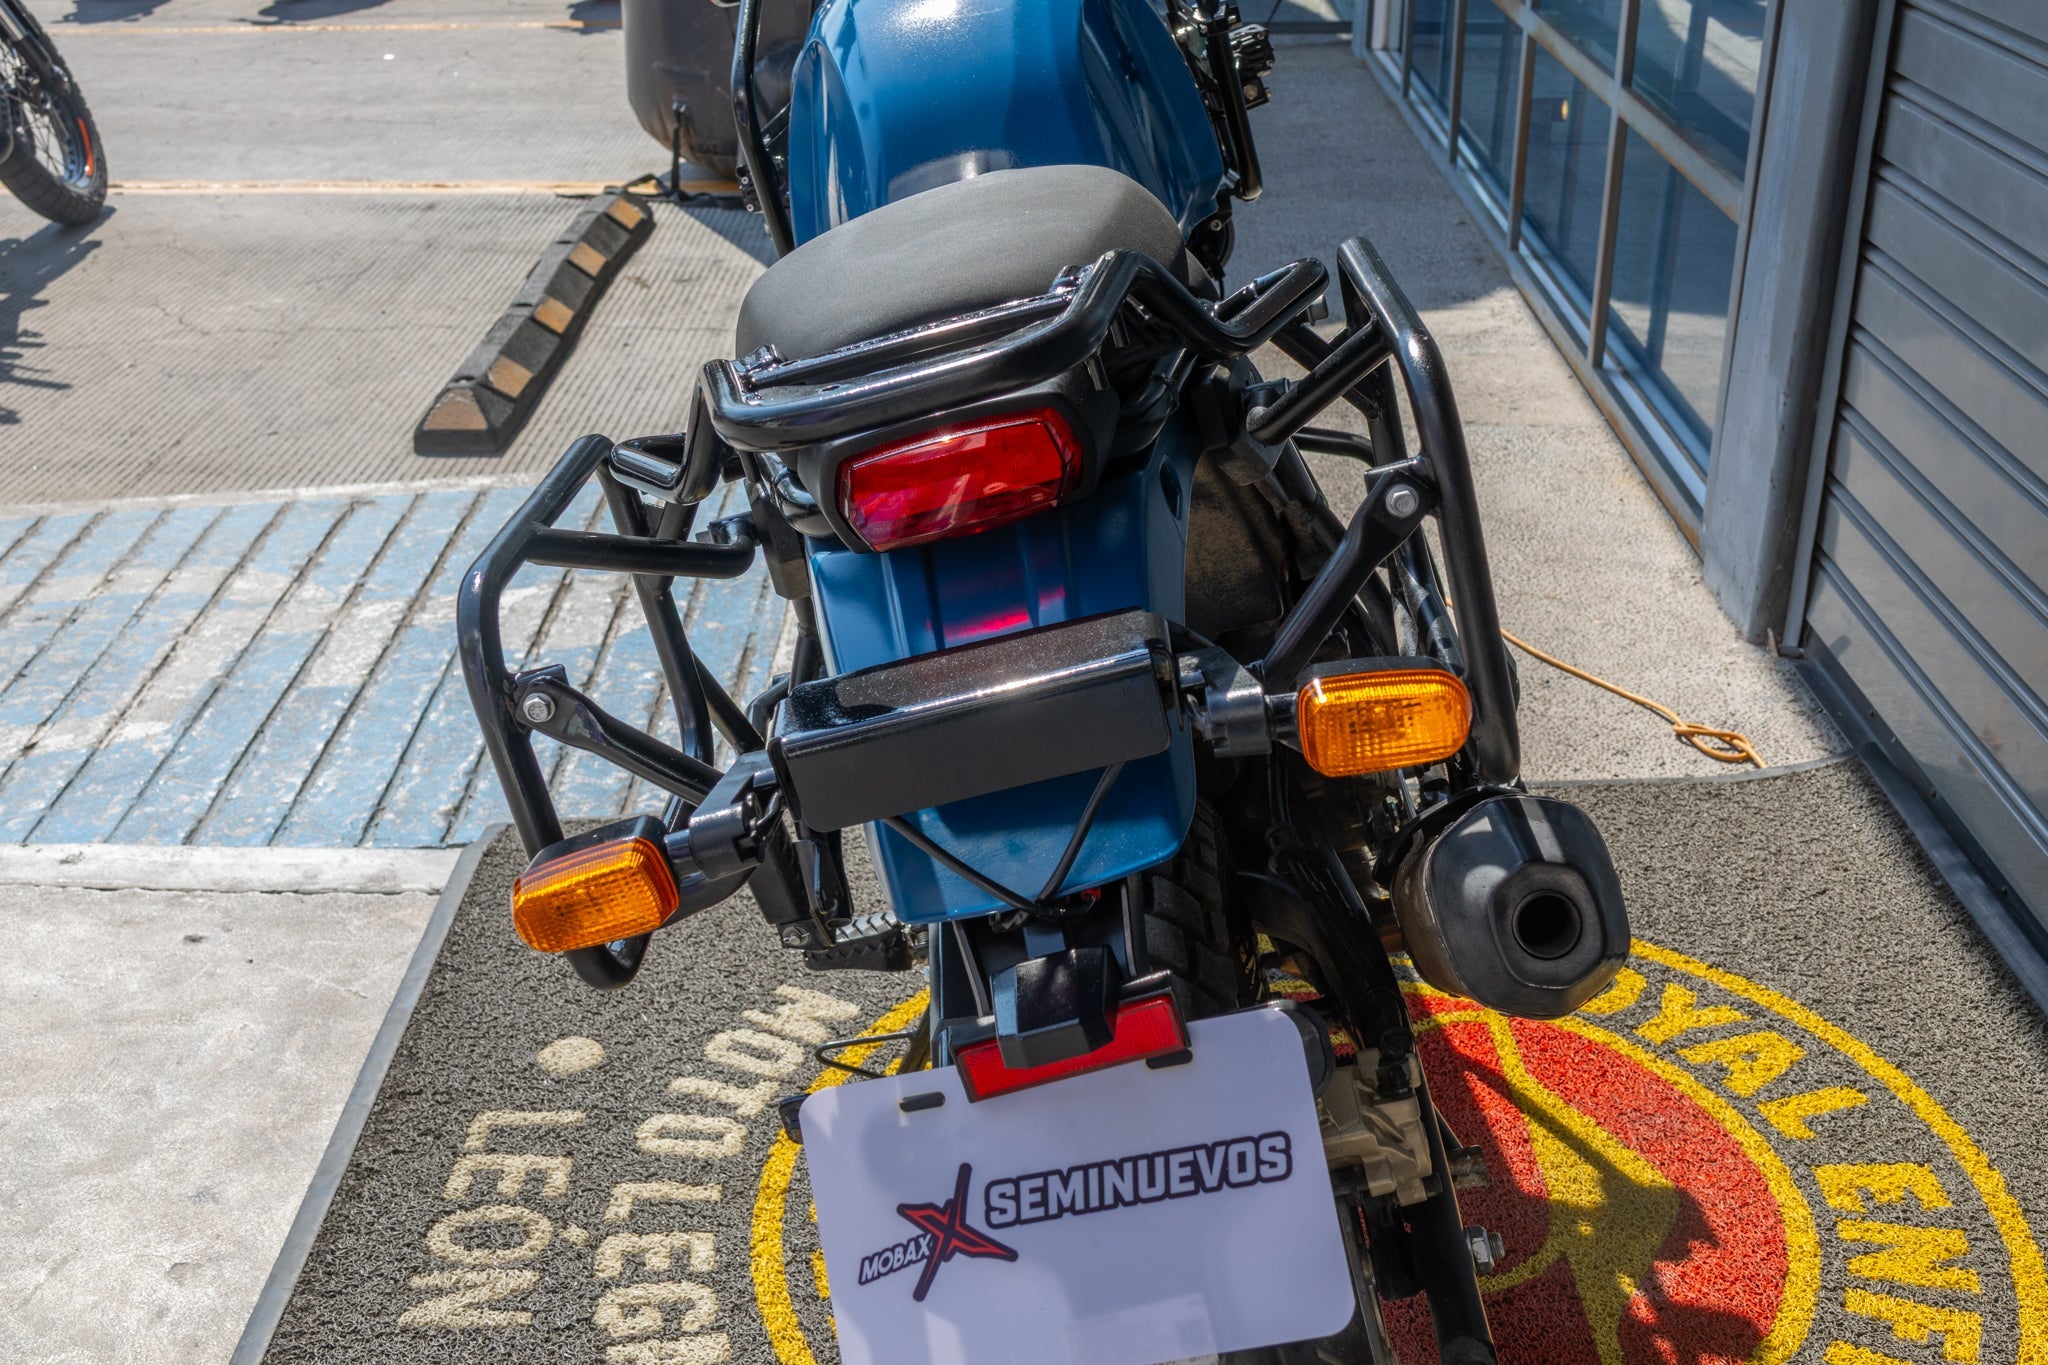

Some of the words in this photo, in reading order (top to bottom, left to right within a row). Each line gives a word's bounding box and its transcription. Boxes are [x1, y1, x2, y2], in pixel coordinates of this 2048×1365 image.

[635, 984, 861, 1159] MOTO
[399, 1110, 590, 1329] LEÓN
[985, 1131, 1292, 1229] SEMINUEVOS
[858, 1233, 934, 1285] MOBAX
